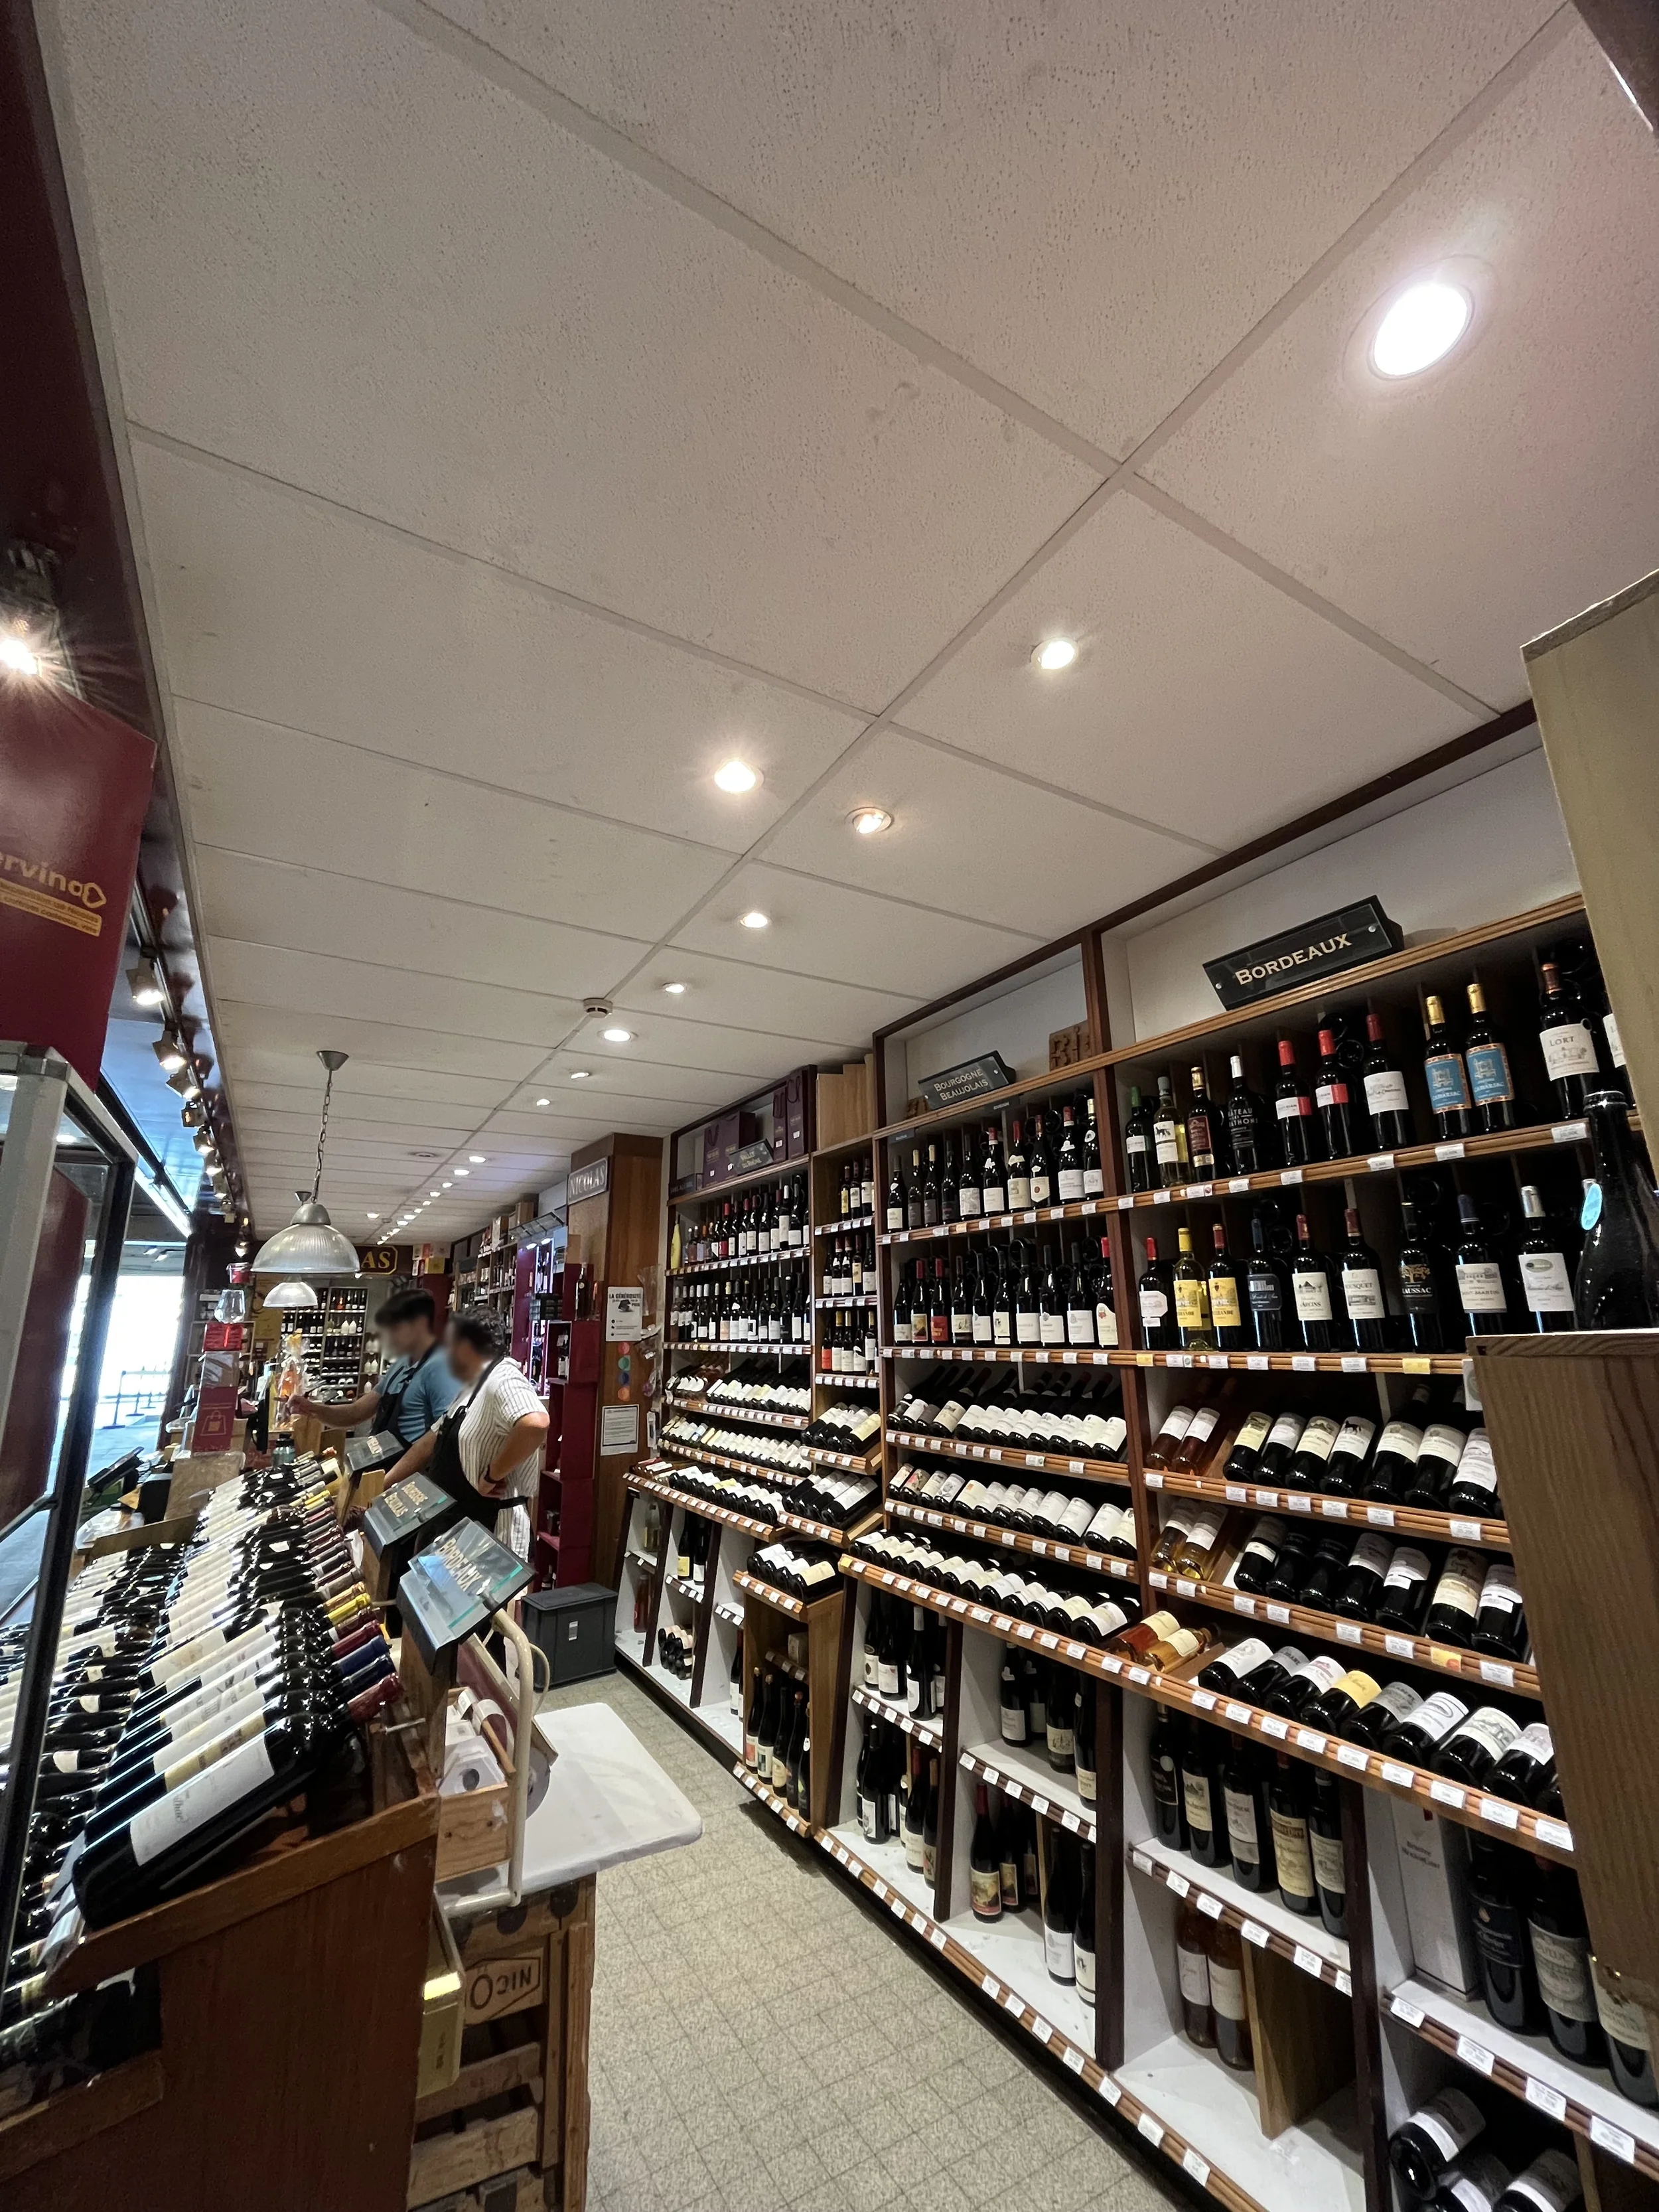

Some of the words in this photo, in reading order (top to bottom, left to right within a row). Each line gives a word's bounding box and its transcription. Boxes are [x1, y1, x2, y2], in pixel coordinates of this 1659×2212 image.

[0, 853, 82, 896] rvino
[1235, 933, 1352, 985] BORDEAUX
[934, 1069, 983, 1092] BOURGOGNE
[940, 1079, 989, 1100] BEAUJOLAIS
[569, 1165, 605, 1197] NICOLAS
[435, 1538, 482, 1591] BORDEAUX
[470, 1966, 532, 2010] NICO
